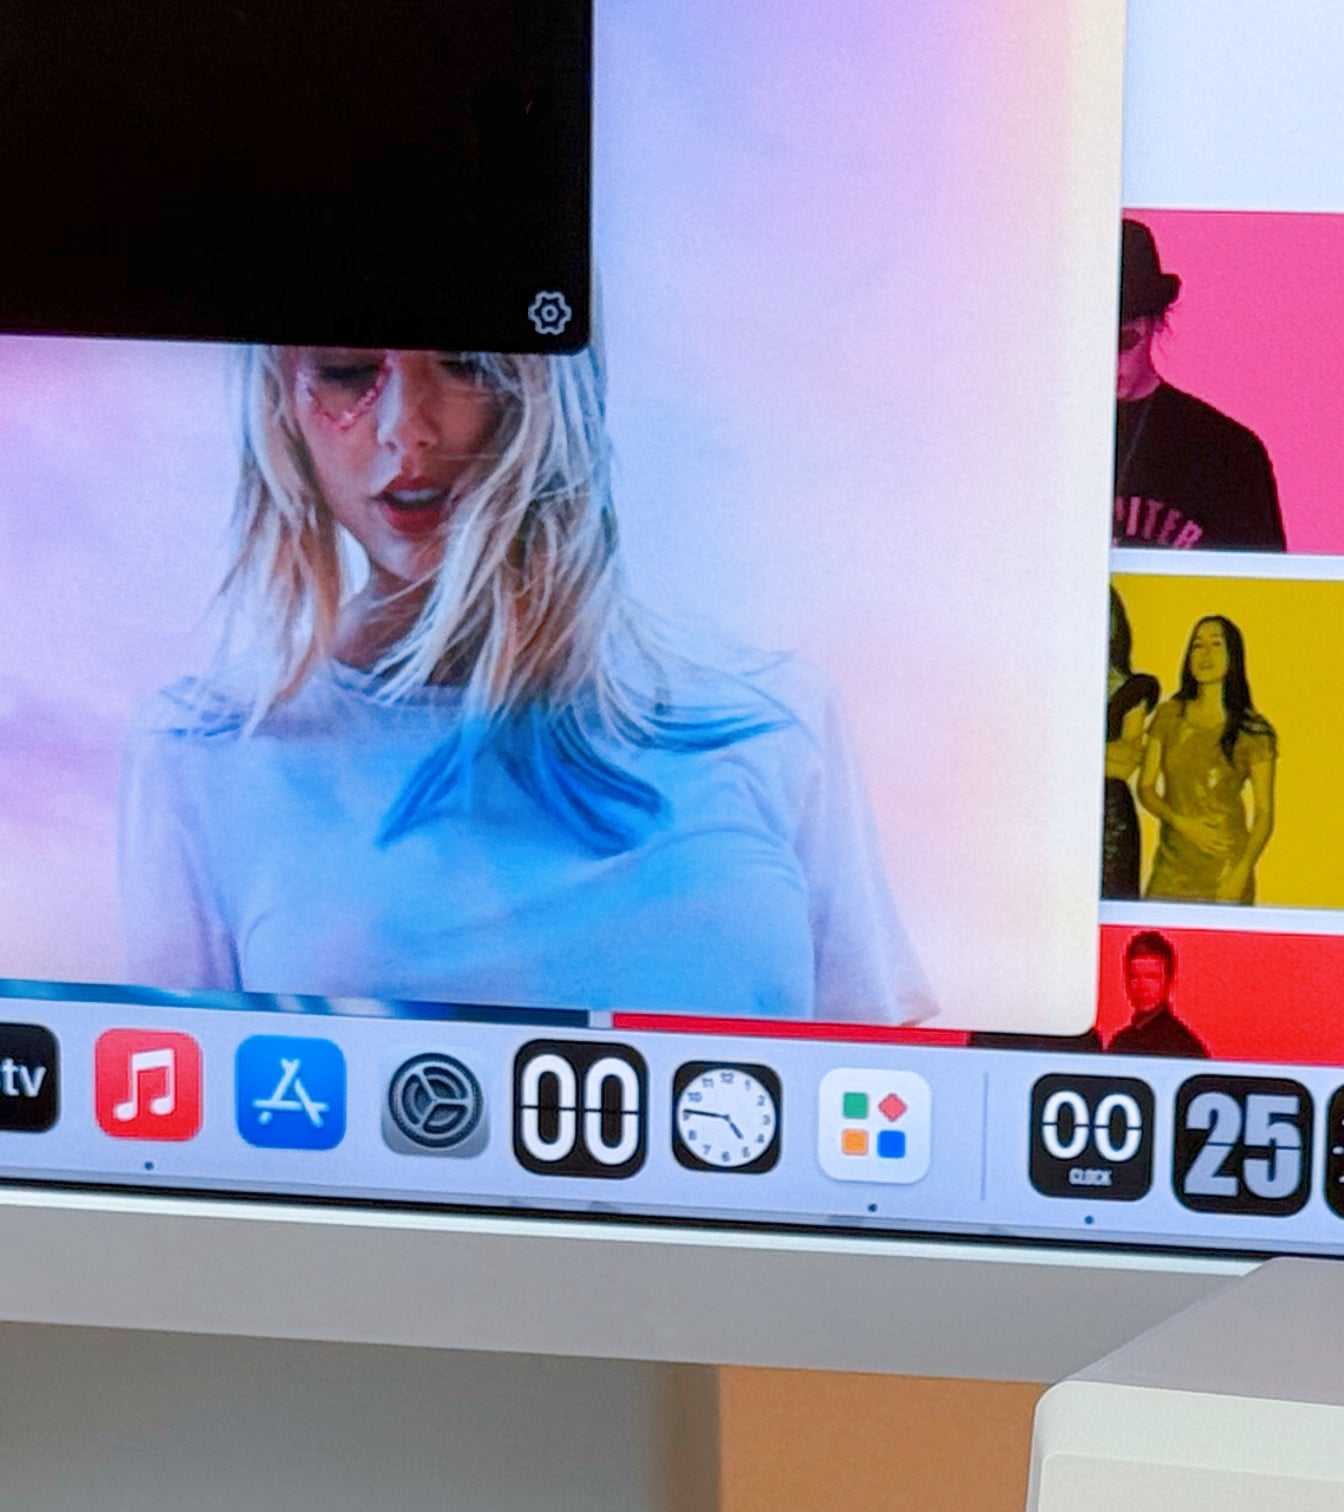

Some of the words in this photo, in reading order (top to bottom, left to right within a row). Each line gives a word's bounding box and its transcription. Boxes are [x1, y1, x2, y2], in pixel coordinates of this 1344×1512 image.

[2, 1059, 46, 1097] tv
[522, 1054, 640, 1165] 00
[1042, 1091, 1142, 1162] 00
[1184, 1092, 1301, 1199] 25
